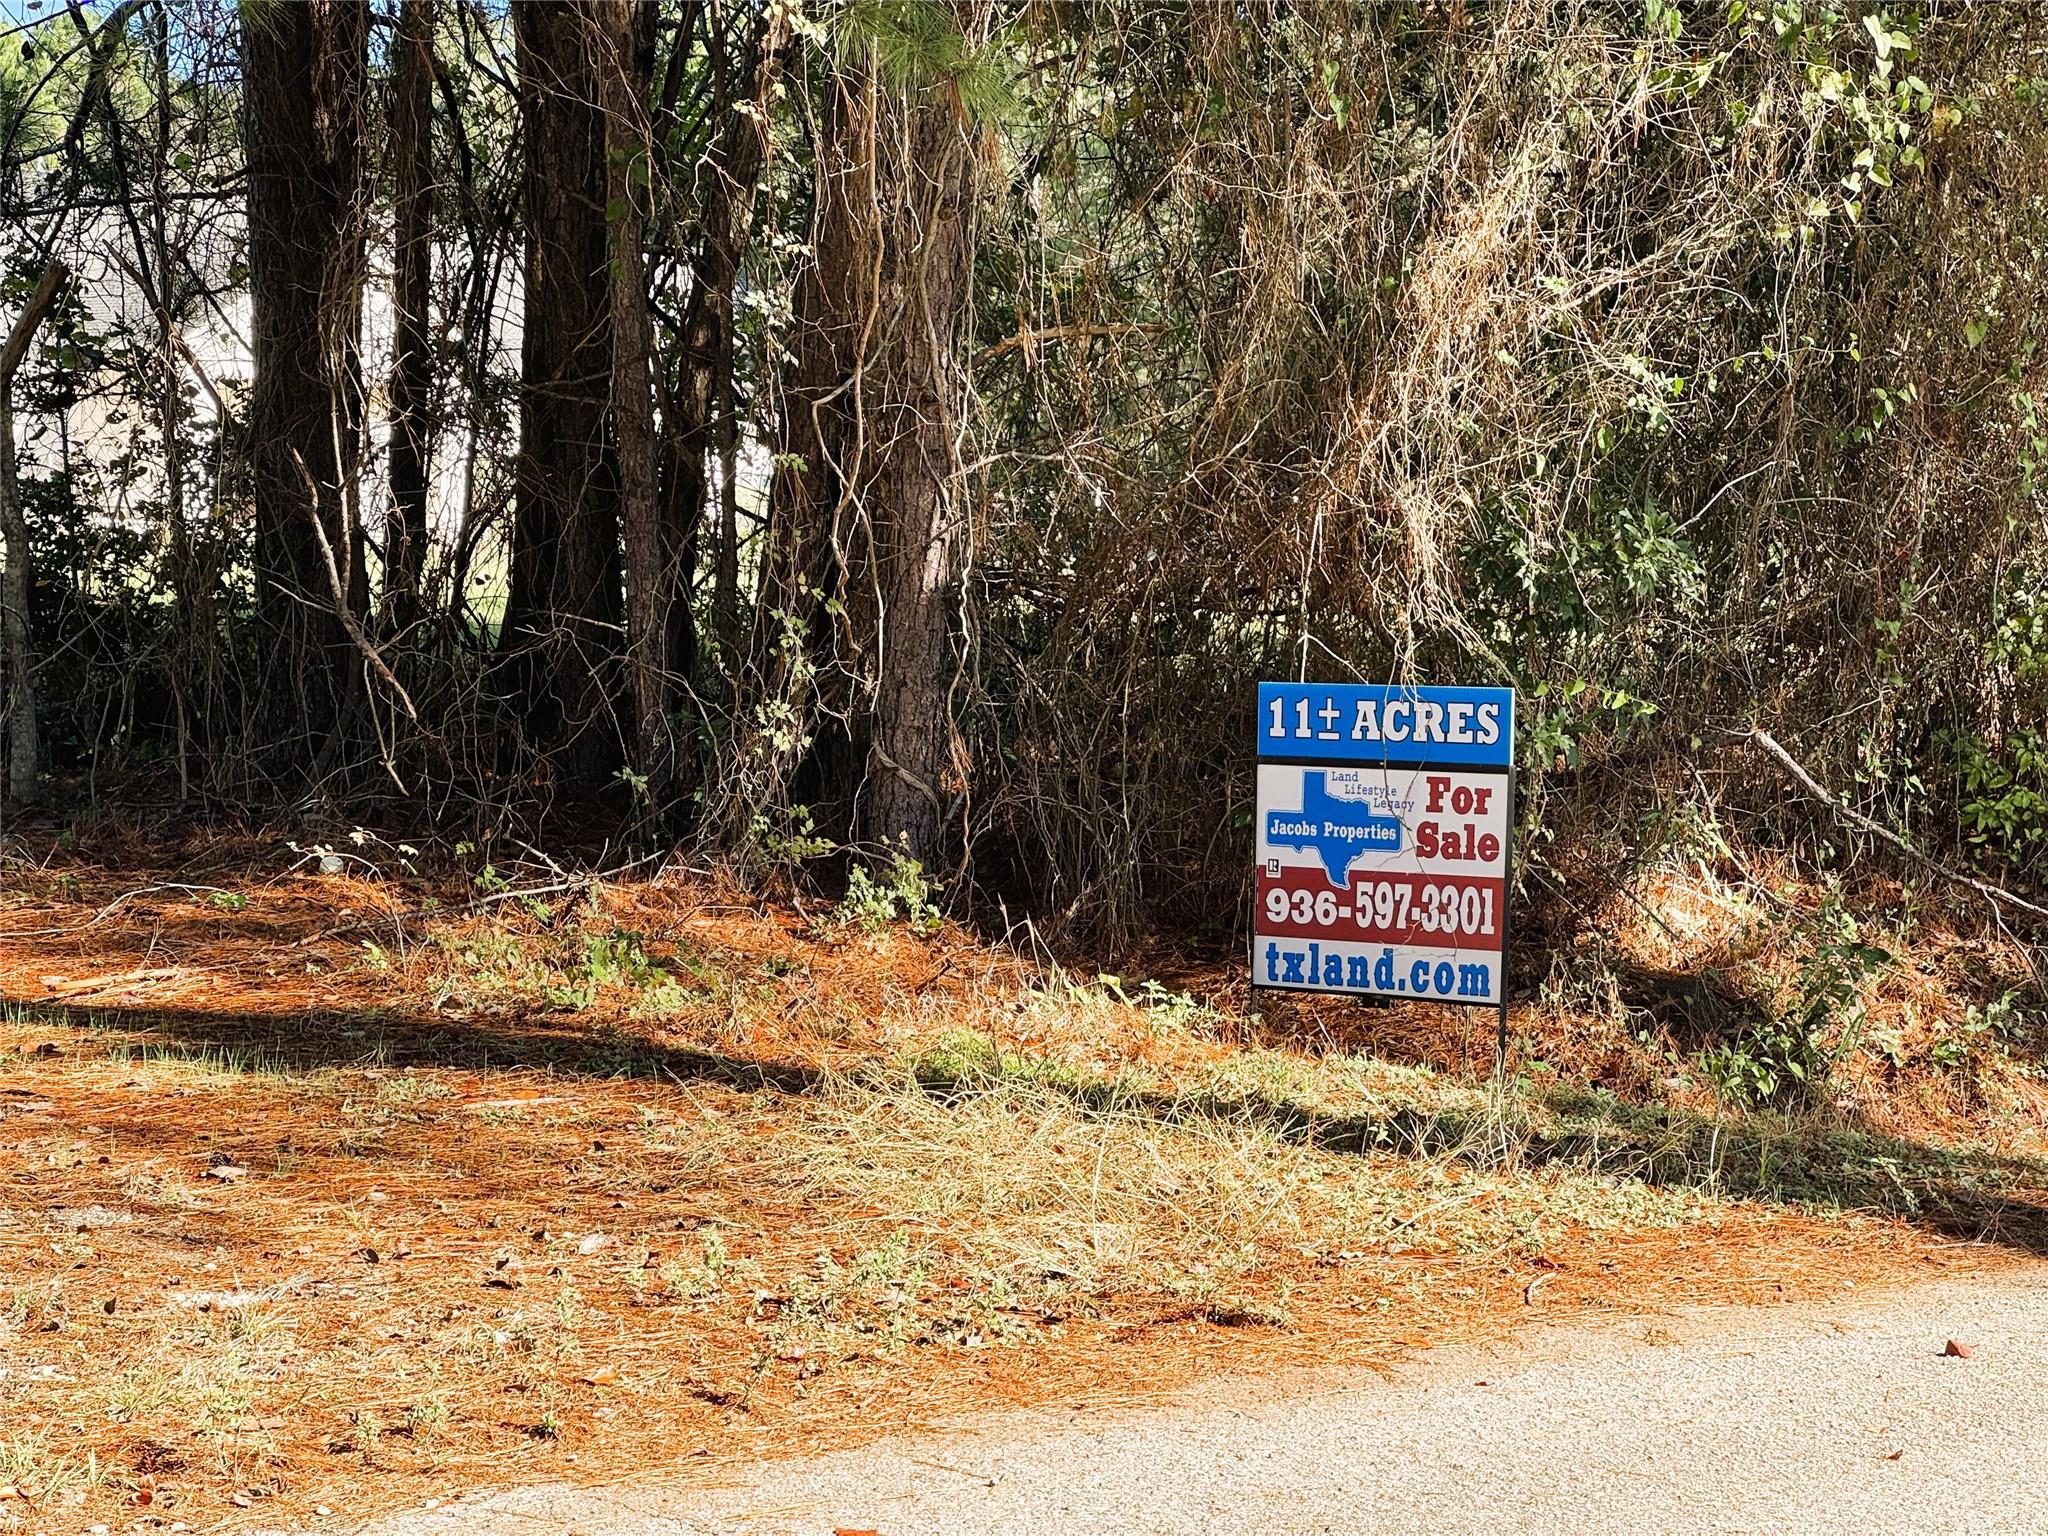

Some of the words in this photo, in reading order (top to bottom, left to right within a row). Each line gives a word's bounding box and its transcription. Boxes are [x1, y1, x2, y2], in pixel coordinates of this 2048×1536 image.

[1351, 699, 1501, 745] ACRES
[1331, 771, 1359, 782] Land
[1344, 784, 1397, 798] Lifestyle
[1426, 776, 1492, 815] For
[1373, 798, 1415, 812] Legacy
[1270, 819, 1318, 836] Jacobs
[1323, 821, 1397, 843] Properties
[1416, 820, 1500, 863] Sale
[1265, 880, 1495, 936] 936-597-3301
[1265, 942, 1491, 998] txland.com
